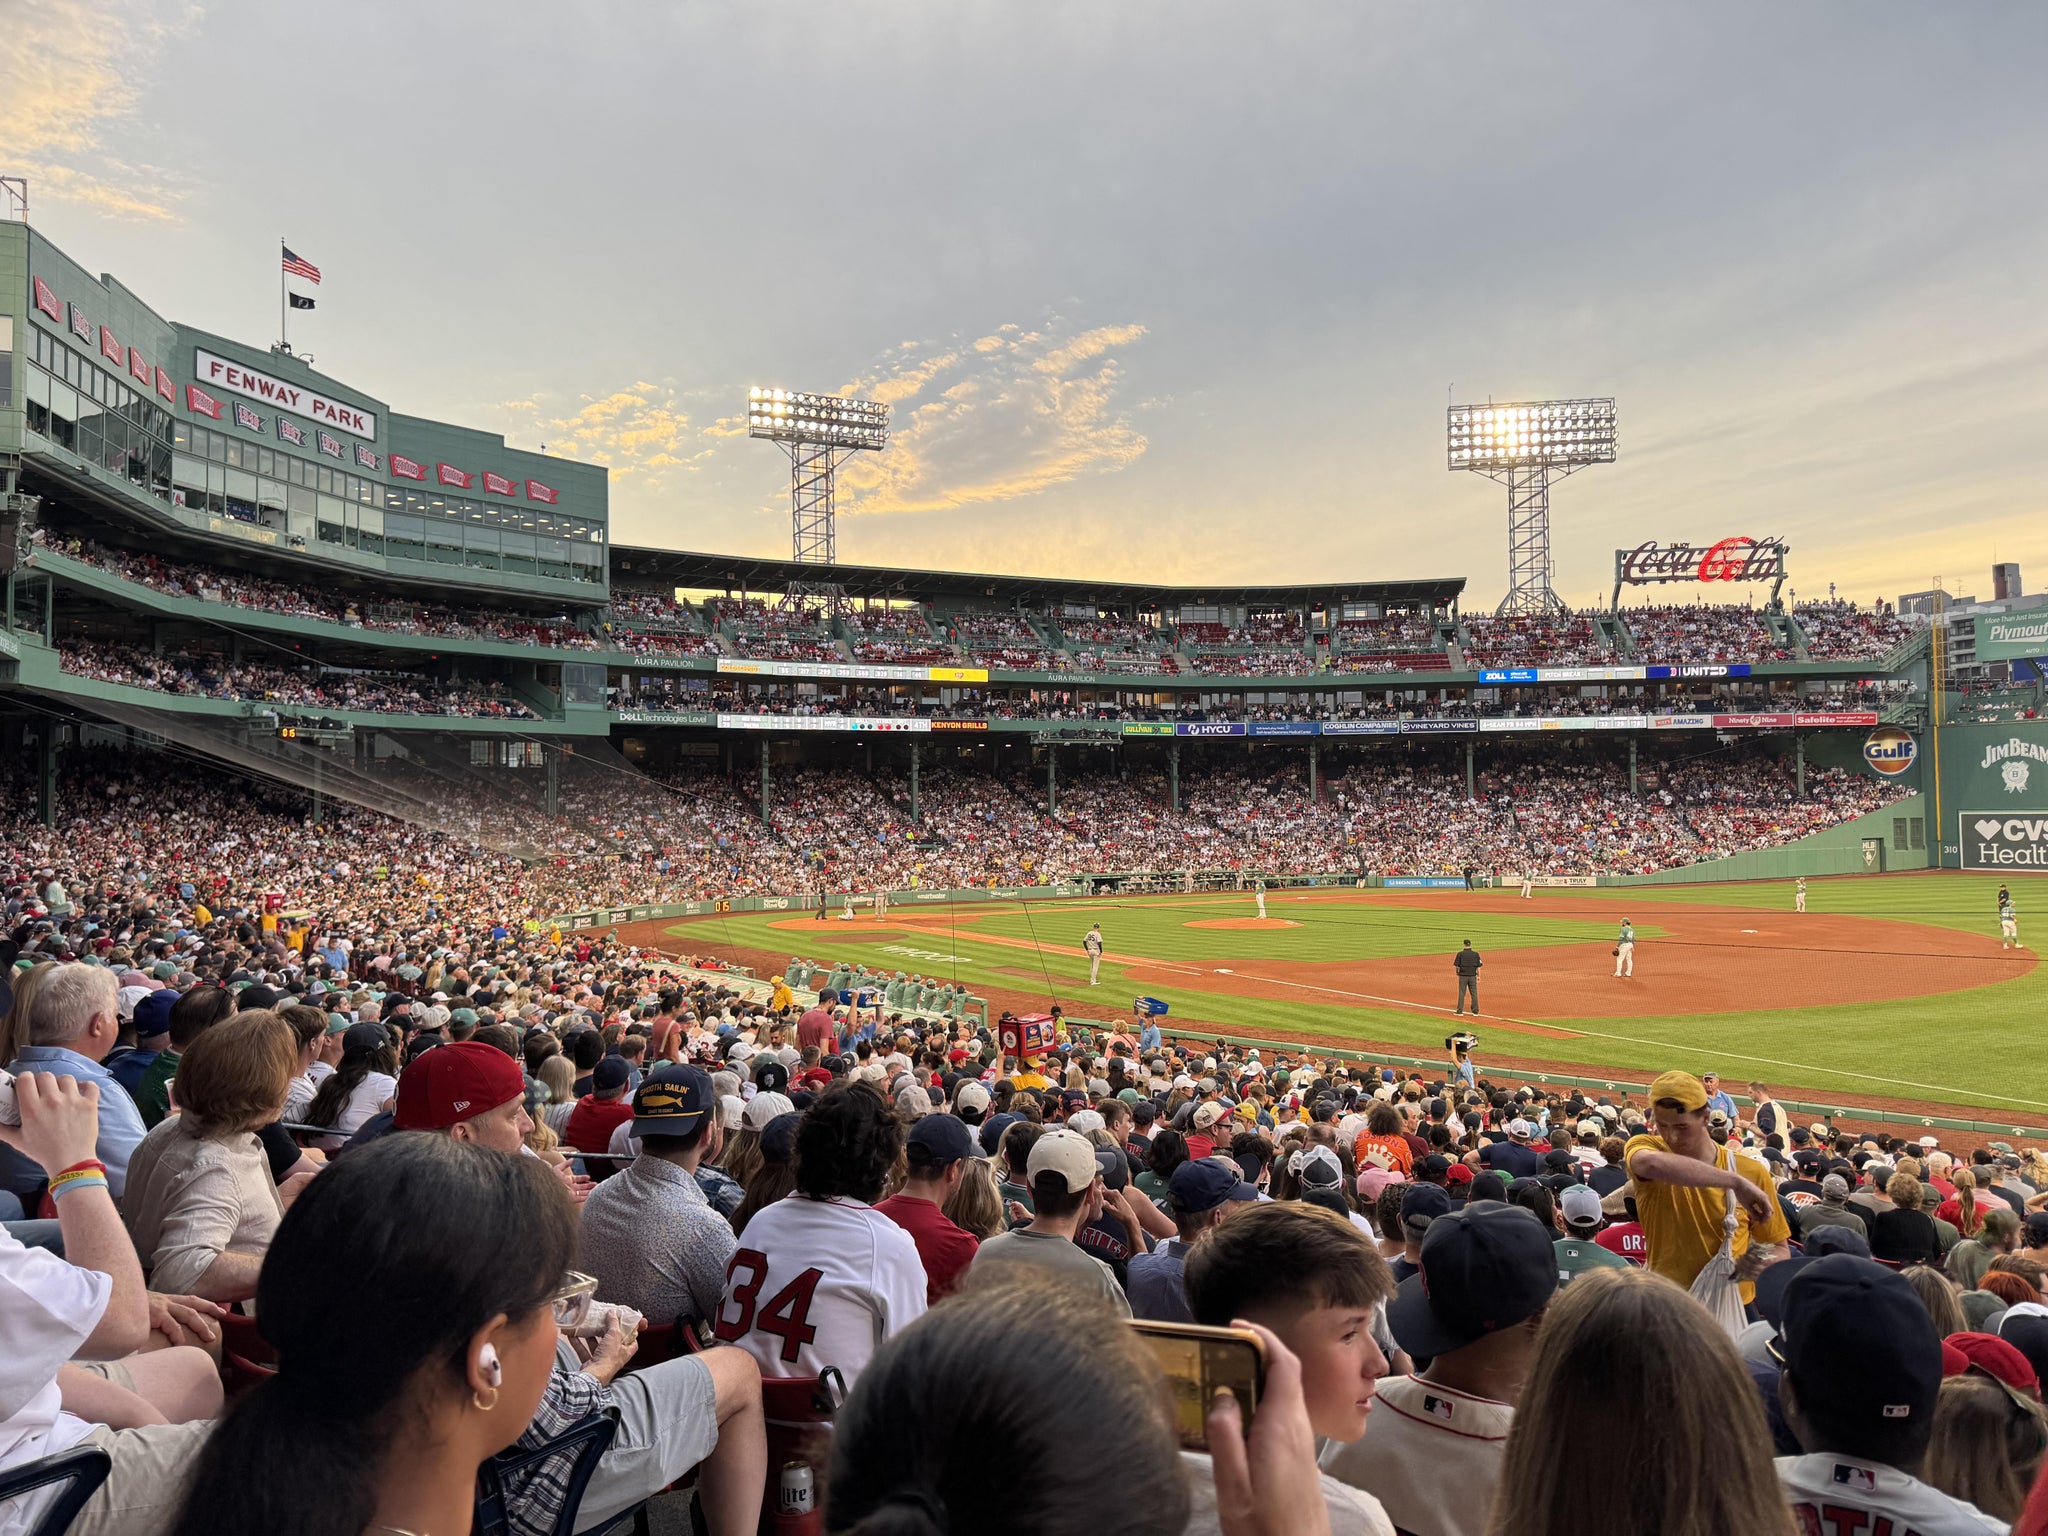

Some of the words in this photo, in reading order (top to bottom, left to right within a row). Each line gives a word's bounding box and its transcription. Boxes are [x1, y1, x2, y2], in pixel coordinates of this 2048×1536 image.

[211, 361, 301, 407] FENWAY
[313, 399, 364, 431] PARK
[1985, 617, 2000, 625] More
[660, 656, 694, 668] PAVILION
[1683, 666, 1727, 676] UNITED
[619, 713, 642, 722] DELL
[642, 713, 688, 724] Technologies
[688, 714, 707, 724] Level
[1673, 718, 1703, 726] AMAZING
[1729, 717, 1749, 725] Ninety
[1797, 716, 1835, 724] Safelite
[931, 721, 958, 729] KENYON
[1125, 725, 1152, 733] SULLIVAN
[1202, 725, 1230, 733] HYCU
[1865, 742, 1913, 758] Gulf
[1981, 744, 2009, 769] JIM
[1944, 846, 1958, 854] 310
[1978, 843, 2048, 864] Healt
[640, 1083, 662, 1097] SMOOTH
[715, 1247, 825, 1364] 34
